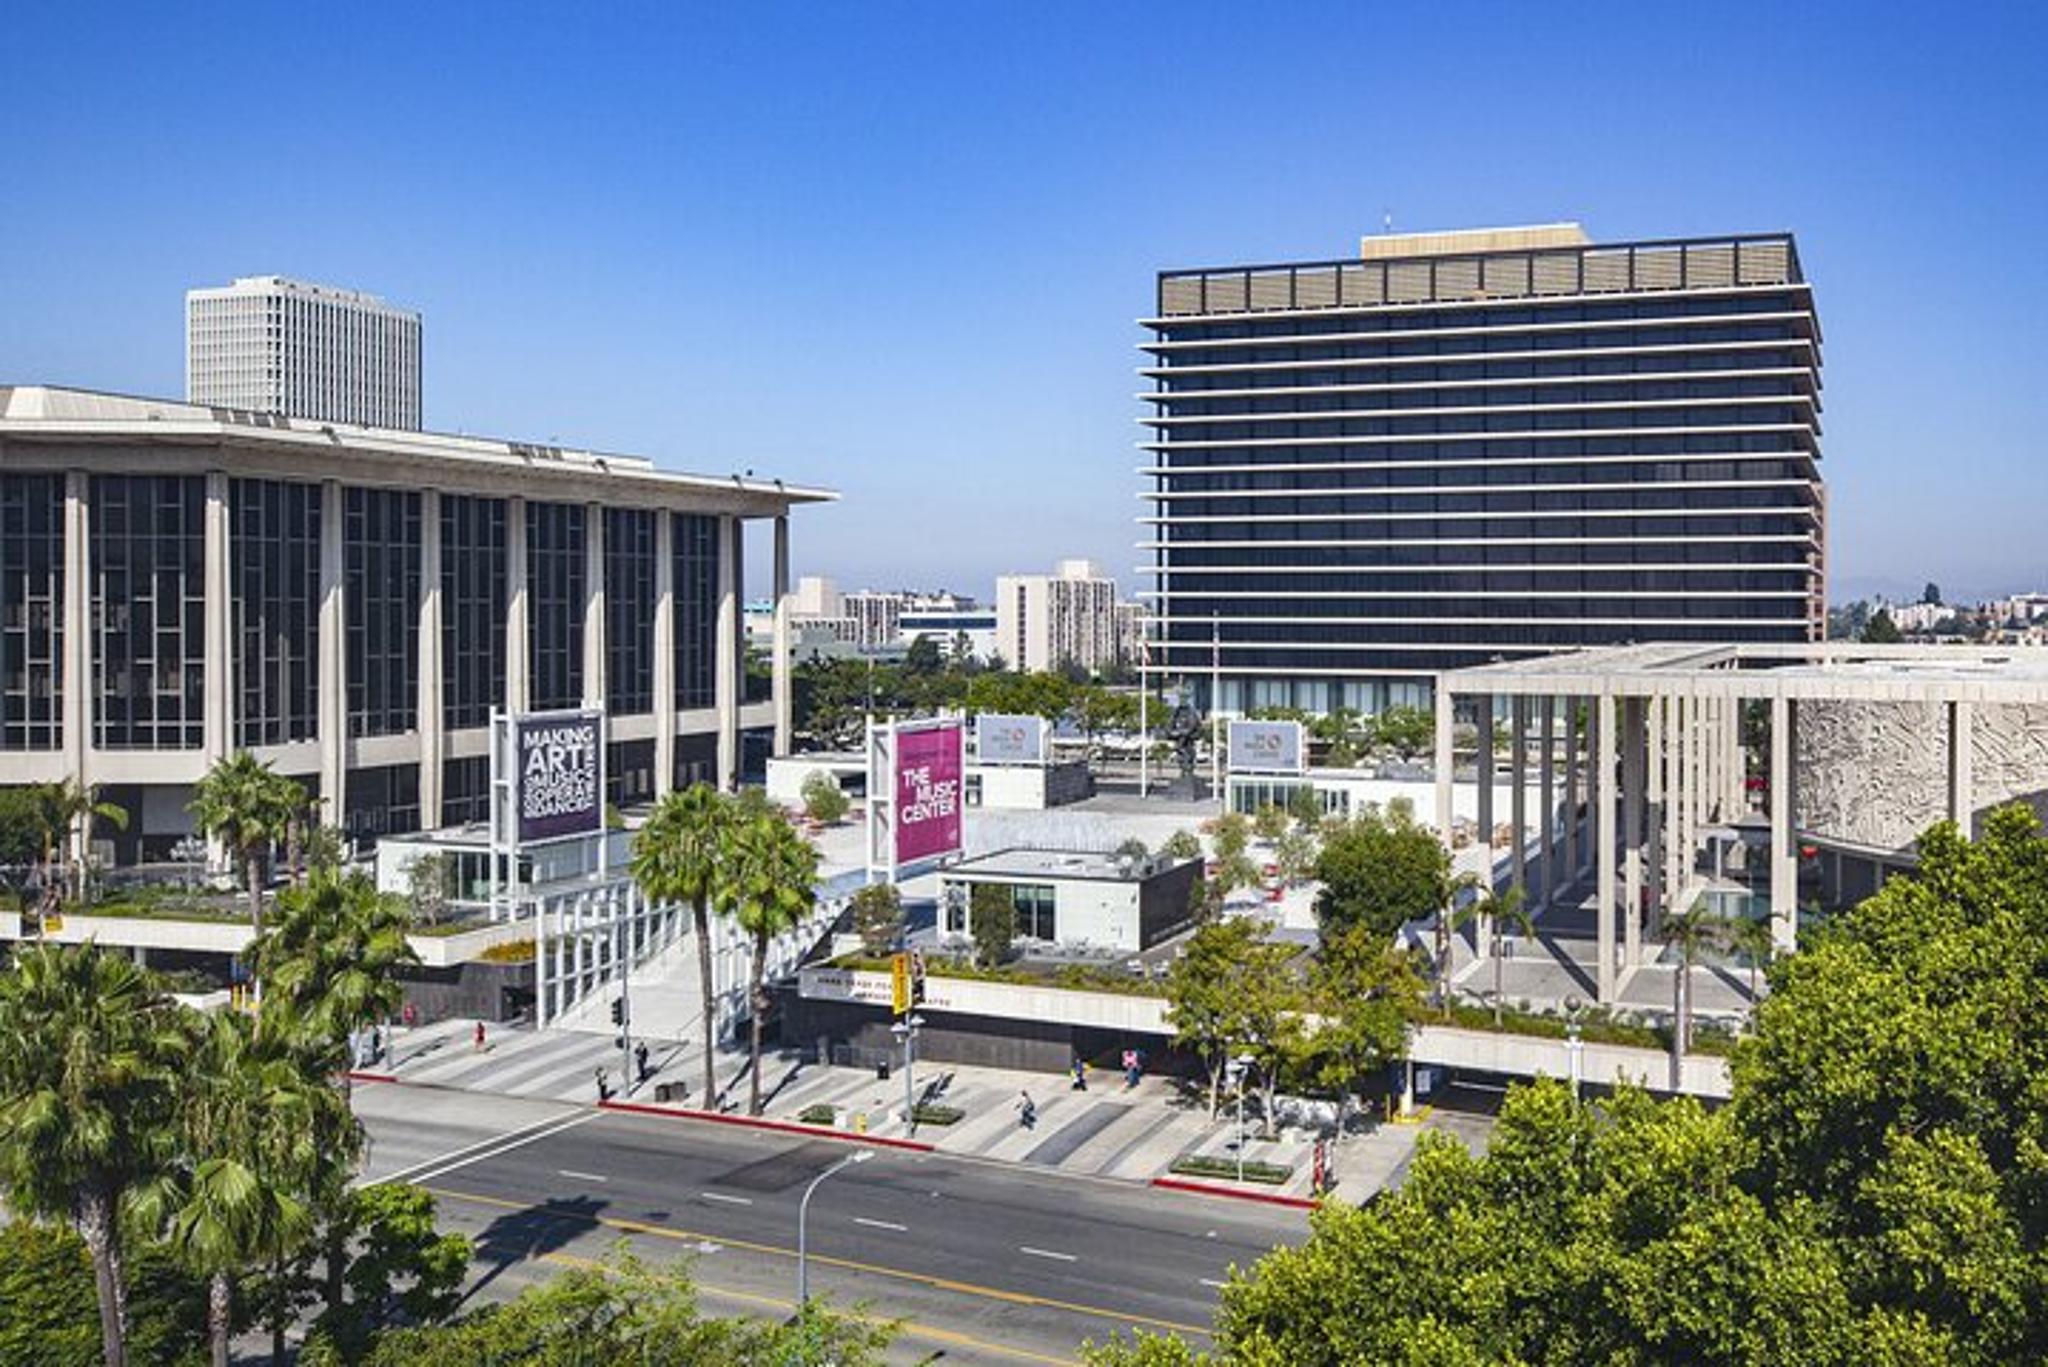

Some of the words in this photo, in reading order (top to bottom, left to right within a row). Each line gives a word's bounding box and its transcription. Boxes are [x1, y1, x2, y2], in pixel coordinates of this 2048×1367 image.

[524, 726, 594, 749] MAKING
[526, 744, 582, 775] ART
[902, 766, 930, 788] THE
[915, 780, 957, 803] MUSIC
[902, 801, 955, 824] CENTER
